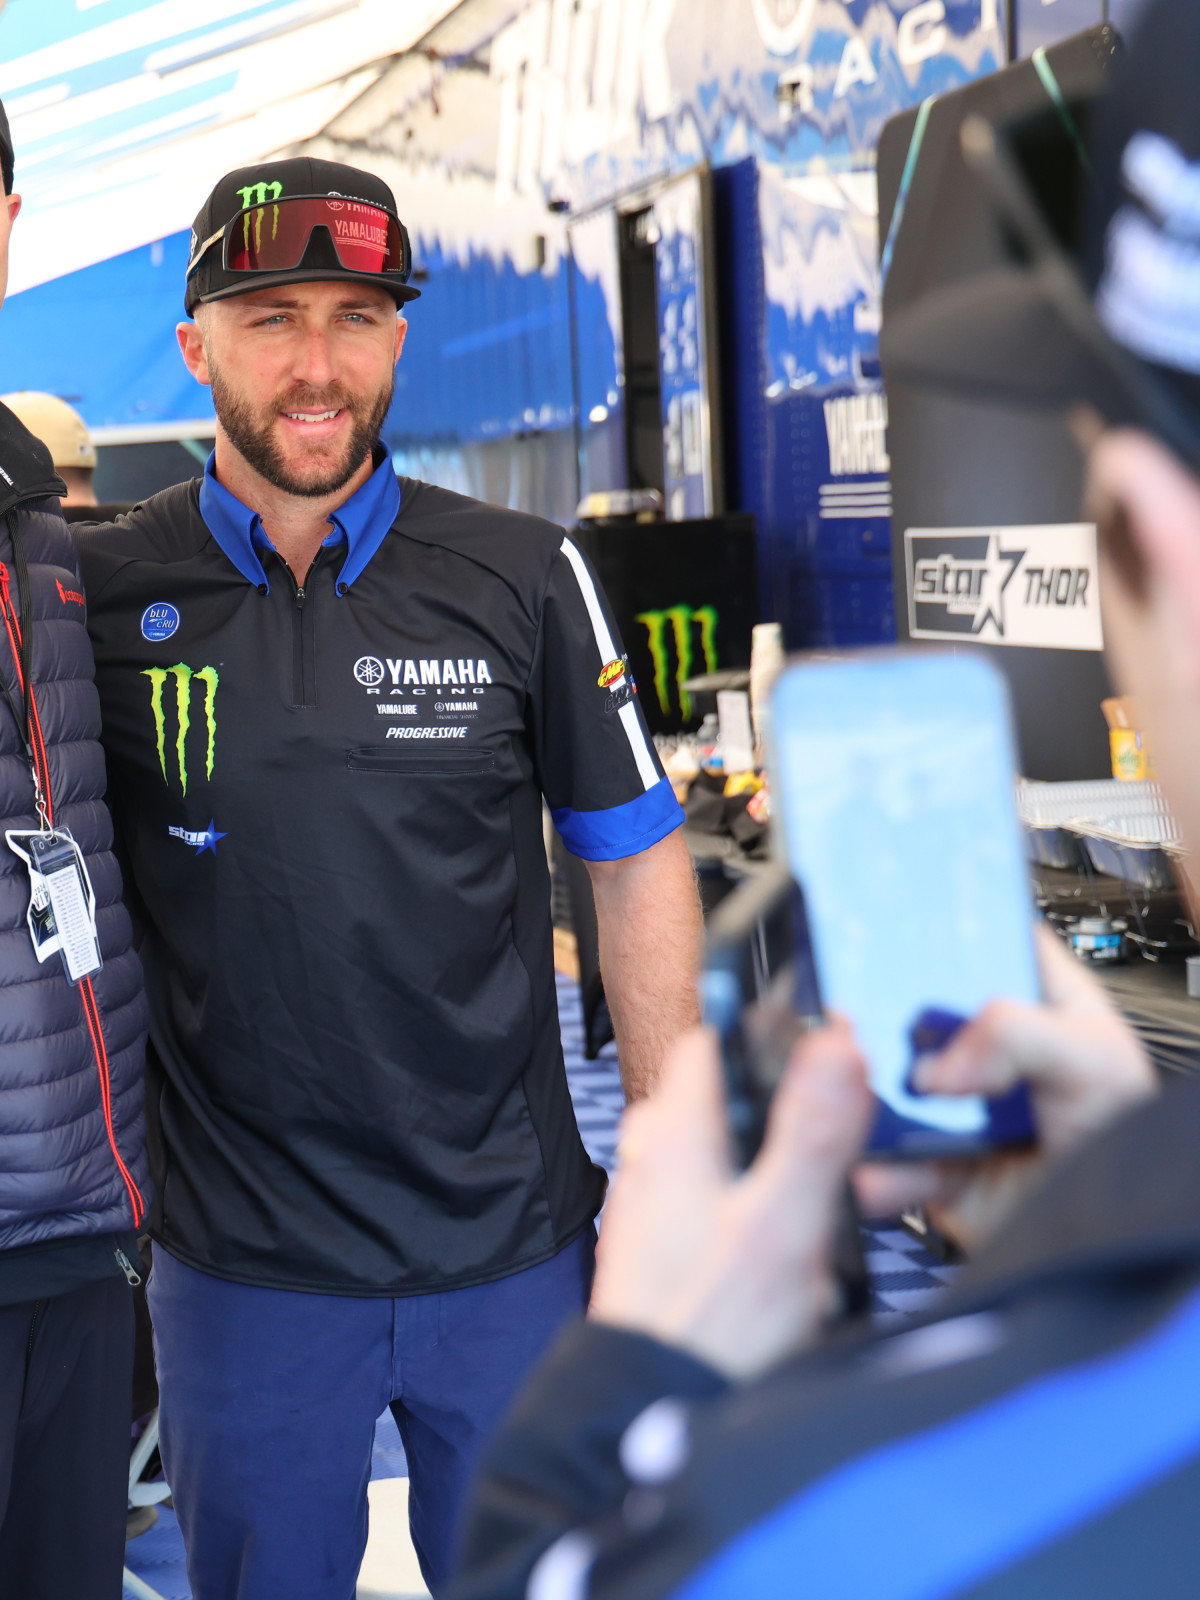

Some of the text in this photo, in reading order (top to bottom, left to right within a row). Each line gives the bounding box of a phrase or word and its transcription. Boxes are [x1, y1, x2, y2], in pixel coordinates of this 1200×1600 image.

[335, 219, 386, 246] YAMALUBE
[1025, 568, 1089, 607] THOR
[385, 658, 492, 685] YAMAHA
[366, 687, 485, 695] RACING
[376, 703, 418, 715] YAMALUBE
[444, 701, 478, 711] YAMAHA
[385, 726, 468, 739] PROGRESSIVE
